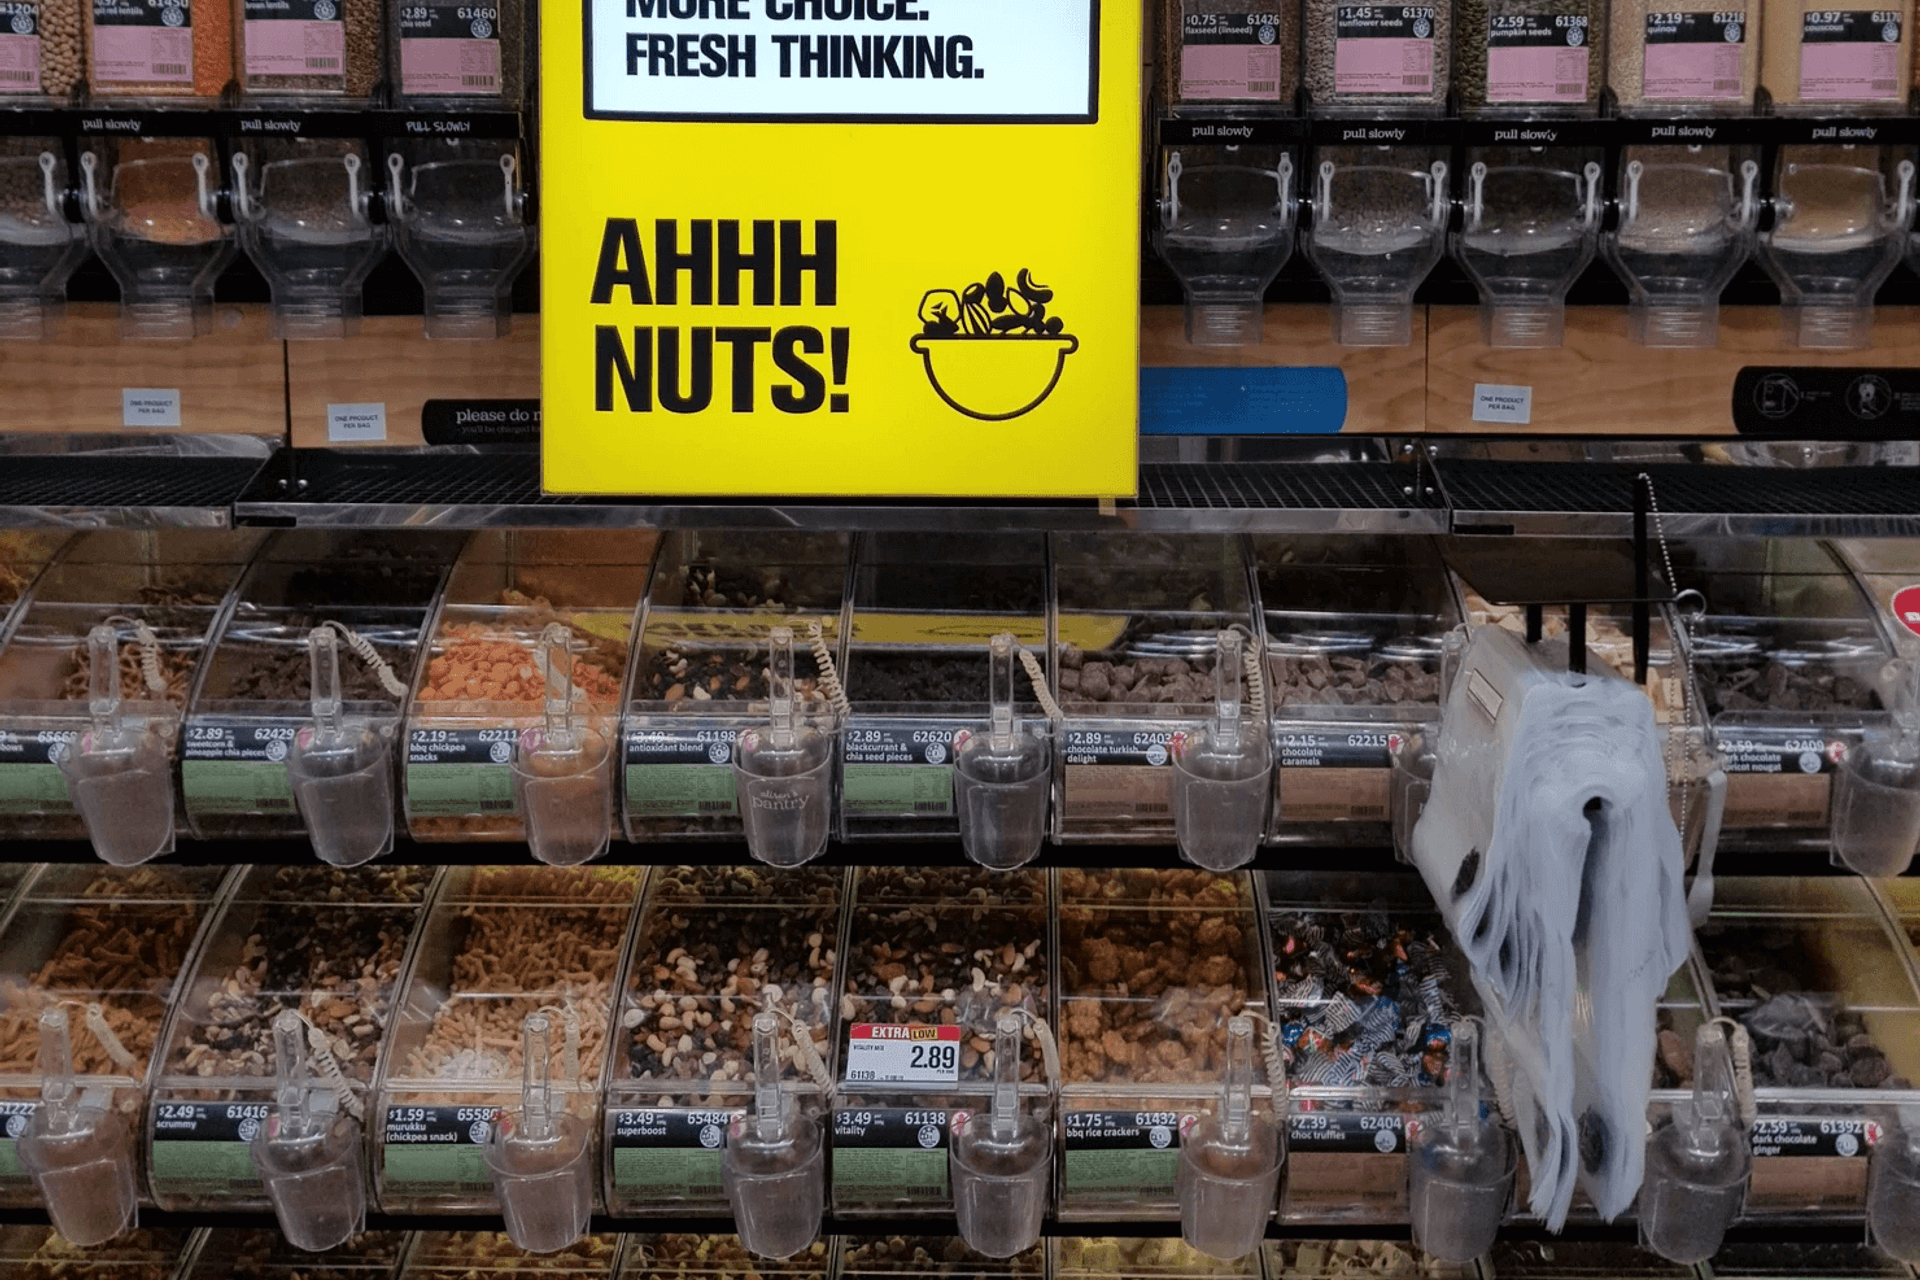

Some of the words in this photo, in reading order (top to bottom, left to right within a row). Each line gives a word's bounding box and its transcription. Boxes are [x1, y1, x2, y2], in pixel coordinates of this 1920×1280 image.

[458, 8, 497, 19] 61460
[1340, 8, 1371, 19] $1.45
[1402, 8, 1434, 19] 61370
[1649, 13, 1682, 24] $2.19
[1713, 12, 1744, 23] 61218
[1806, 12, 1840, 23] $0.97
[1186, 14, 1216, 26] $0.75
[1247, 14, 1279, 26] 61426
[1338, 19, 1380, 27] sunflower
[1382, 19, 1403, 27] seeds
[1492, 16, 1524, 27] $2.59
[1555, 16, 1587, 27] 61368
[1185, 26, 1216, 34] flaxseed
[1218, 26, 1253, 35] (linseed)
[1491, 28, 1526, 37] pumpkin
[1528, 28, 1552, 36] seeds
[1648, 25, 1676, 34] quinoa
[1805, 24, 1844, 32] couscous
[626, 33, 756, 78] FRESH
[771, 34, 984, 78] THINKING.
[82, 118, 103, 130] pull
[105, 119, 140, 131] slowly
[241, 118, 262, 131] pull
[264, 119, 300, 131] slowly
[406, 121, 431, 132] PULL
[433, 121, 470, 132] SLOWLY
[1192, 126, 1214, 137] pull
[1217, 126, 1253, 138] slowly
[1343, 129, 1366, 140] pull
[1368, 129, 1405, 140] slowly
[1495, 129, 1518, 140] pull
[1521, 129, 1557, 141] slowly
[1652, 126, 1675, 137] pull
[1678, 126, 1716, 138] slowly
[1812, 127, 1836, 138] pull
[1838, 127, 1877, 139] slowly
[590, 217, 837, 306] AHHH
[595, 324, 850, 414] NUTS!
[456, 410, 505, 424] please
[509, 410, 529, 421] do
[189, 728, 223, 740] $2.89
[254, 728, 295, 740] 62429
[412, 730, 446, 742] $2.19
[478, 730, 517, 742] 62211
[697, 731, 736, 742] 61198
[848, 730, 881, 742] $2.89
[913, 731, 951, 743] 62620
[1068, 732, 1101, 744] $2.89
[227, 740, 234, 748] &
[1282, 735, 1316, 746] $2.15
[1348, 735, 1386, 746] 62215
[410, 743, 427, 752] bbq
[428, 743, 466, 752] chickpea
[629, 743, 677, 751] antioxidant
[679, 743, 703, 751] blend
[846, 743, 899, 751] blackcurrant
[900, 743, 908, 751] &
[1109, 745, 1138, 753] turkish
[1282, 747, 1322, 756] chocolate
[186, 749, 223, 757] pineapple
[241, 749, 265, 757] pieces
[410, 753, 438, 761] snacks
[846, 753, 863, 761] chia
[865, 753, 884, 761] seed
[886, 753, 913, 762] pieces
[1740, 753, 1781, 761] chocolate
[1067, 755, 1097, 764] delight
[1752, 764, 1782, 773] nougat
[752, 794, 810, 811] pantry
[872, 1027, 910, 1038] EXTRA
[913, 1029, 935, 1039] LOW
[910, 1045, 955, 1069] 2.89
[851, 1070, 876, 1080] 61138
[159, 1105, 194, 1118] $2.49
[227, 1106, 268, 1118] 61416
[389, 1109, 424, 1122] $1.59
[619, 1112, 654, 1125] $3.49
[687, 1113, 728, 1124] 65484
[837, 1112, 871, 1125] $3.49
[905, 1112, 946, 1125] 61138
[1068, 1114, 1102, 1127] $1.75
[1135, 1112, 1176, 1125] 61432
[1292, 1116, 1327, 1129] $2.39
[1360, 1117, 1402, 1129] 62404
[156, 1121, 197, 1130] scrummy
[387, 1122, 426, 1131] murukku
[617, 1126, 666, 1136] superboost
[835, 1126, 865, 1136] vitality
[1820, 1121, 1862, 1133] 61392
[386, 1132, 428, 1142] (chickpea
[429, 1132, 458, 1142] snack)
[1067, 1128, 1084, 1138] bbq
[1085, 1128, 1102, 1137] rice
[1103, 1128, 1140, 1137] crackers
[1291, 1131, 1312, 1139] choc
[1313, 1130, 1345, 1140] truffles
[1752, 1135, 1772, 1144] dark
[1774, 1135, 1817, 1144] chocolate
[1752, 1145, 1781, 1156] ginger
